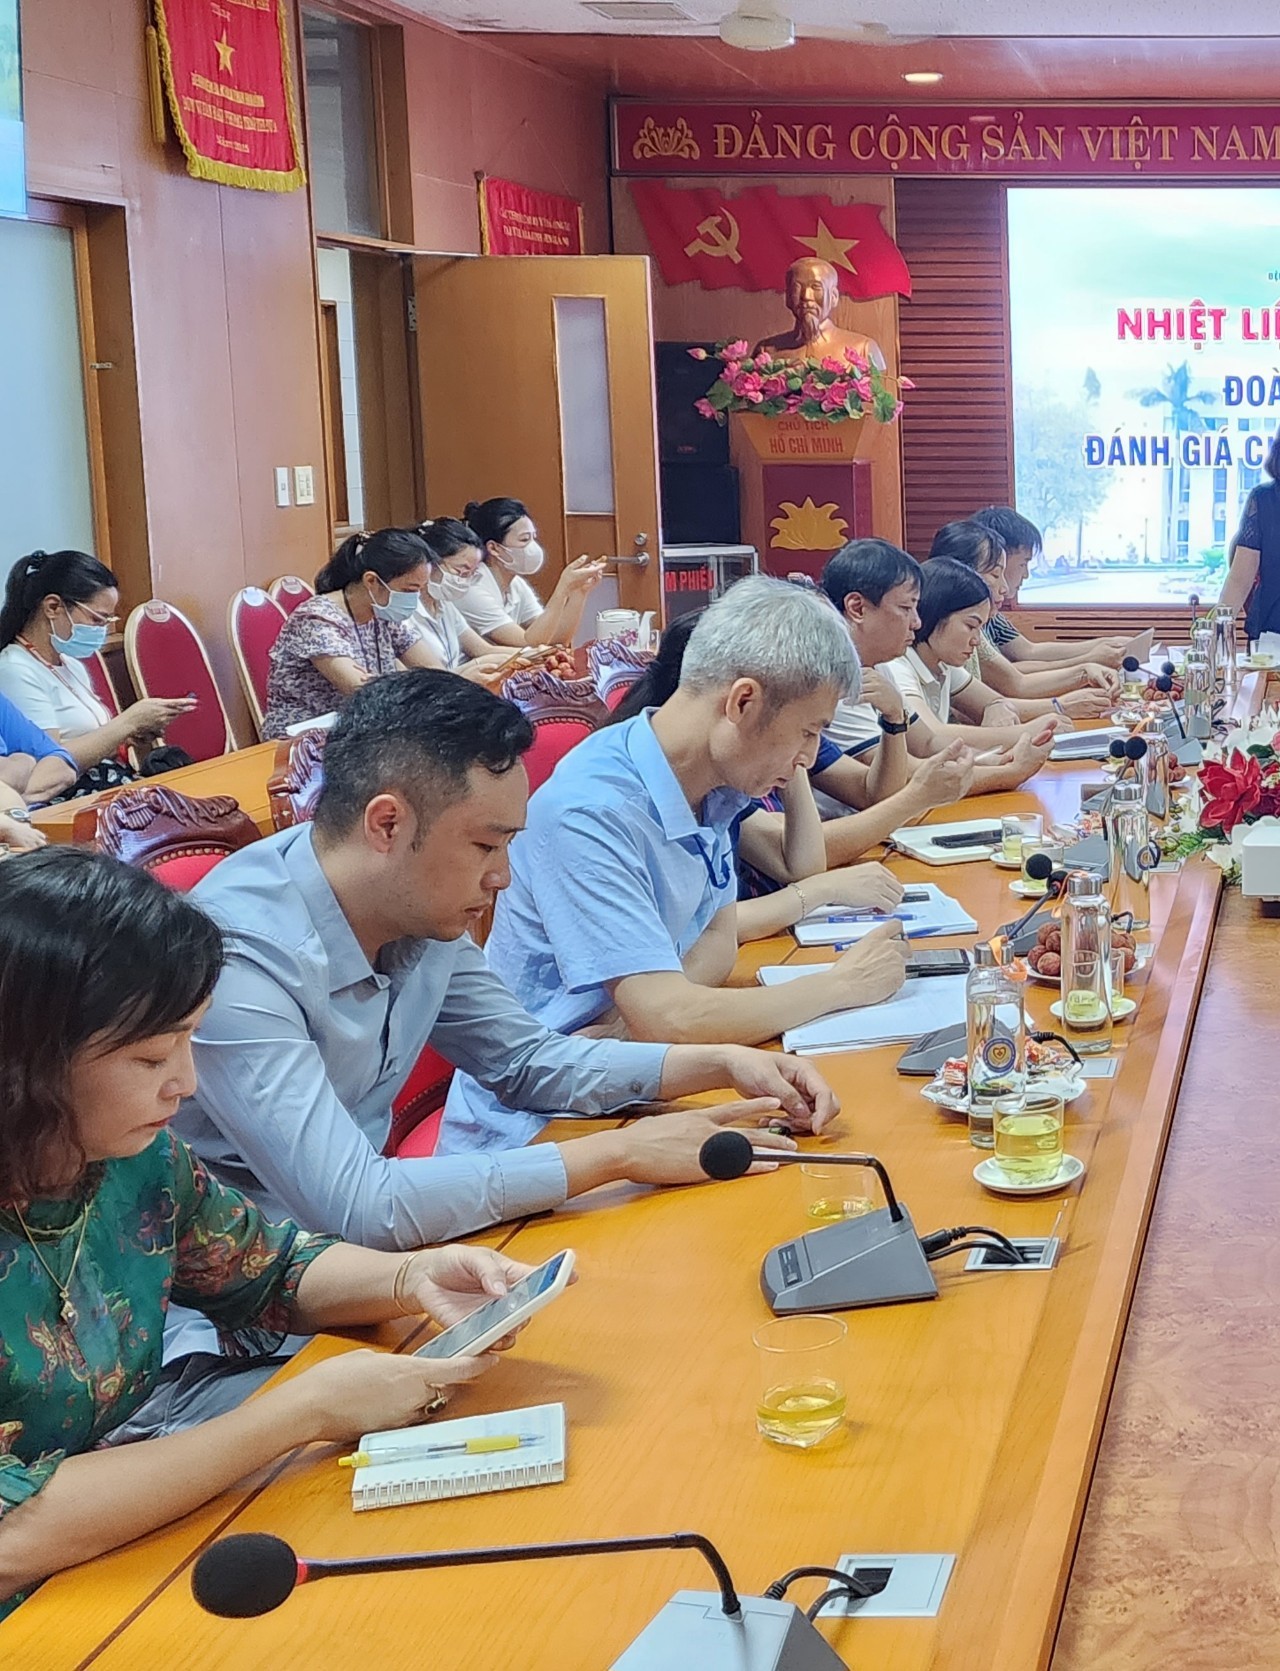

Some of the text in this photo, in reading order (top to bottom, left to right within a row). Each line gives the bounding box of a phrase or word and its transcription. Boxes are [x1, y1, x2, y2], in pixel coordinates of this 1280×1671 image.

[713, 110, 837, 160] ĐẢNG
[850, 114, 970, 170] CỘNG
[981, 112, 1065, 160] SẢN
[1078, 115, 1178, 170] VIỆT
[1117, 299, 1226, 350] NHIỆT
[769, 432, 843, 453] HỒ CHÍ MINH
[1085, 427, 1169, 466] ĐÁNH
[1182, 427, 1233, 466] GIÁ
[680, 563, 715, 591] PHIẾU
